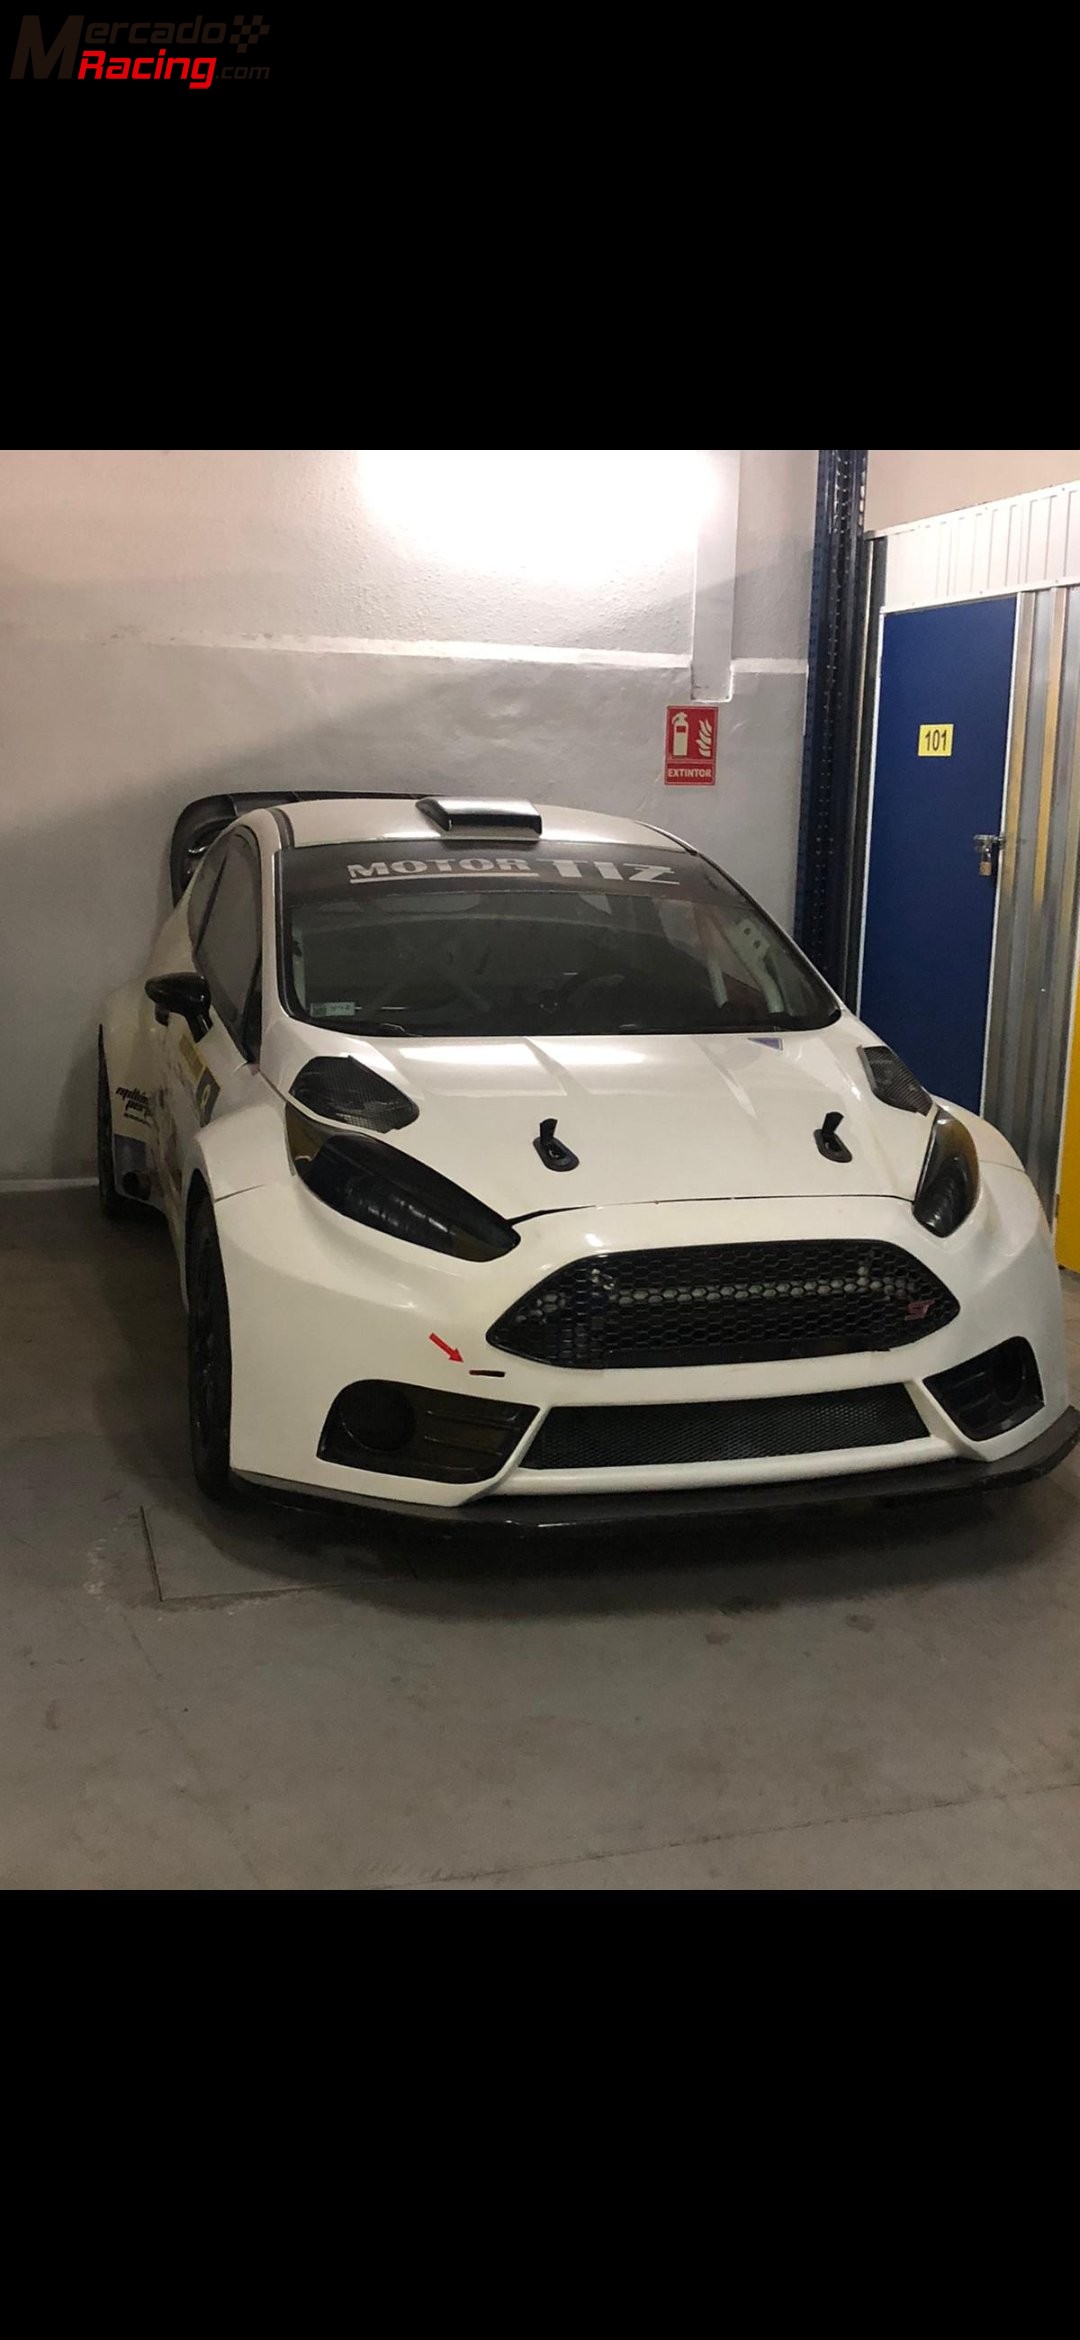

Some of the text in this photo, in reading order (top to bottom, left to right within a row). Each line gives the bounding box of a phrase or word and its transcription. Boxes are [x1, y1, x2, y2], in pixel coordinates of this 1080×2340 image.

[925, 729, 947, 752] 101
[668, 768, 712, 777] EXTINTOR
[347, 858, 531, 878] MOTOR
